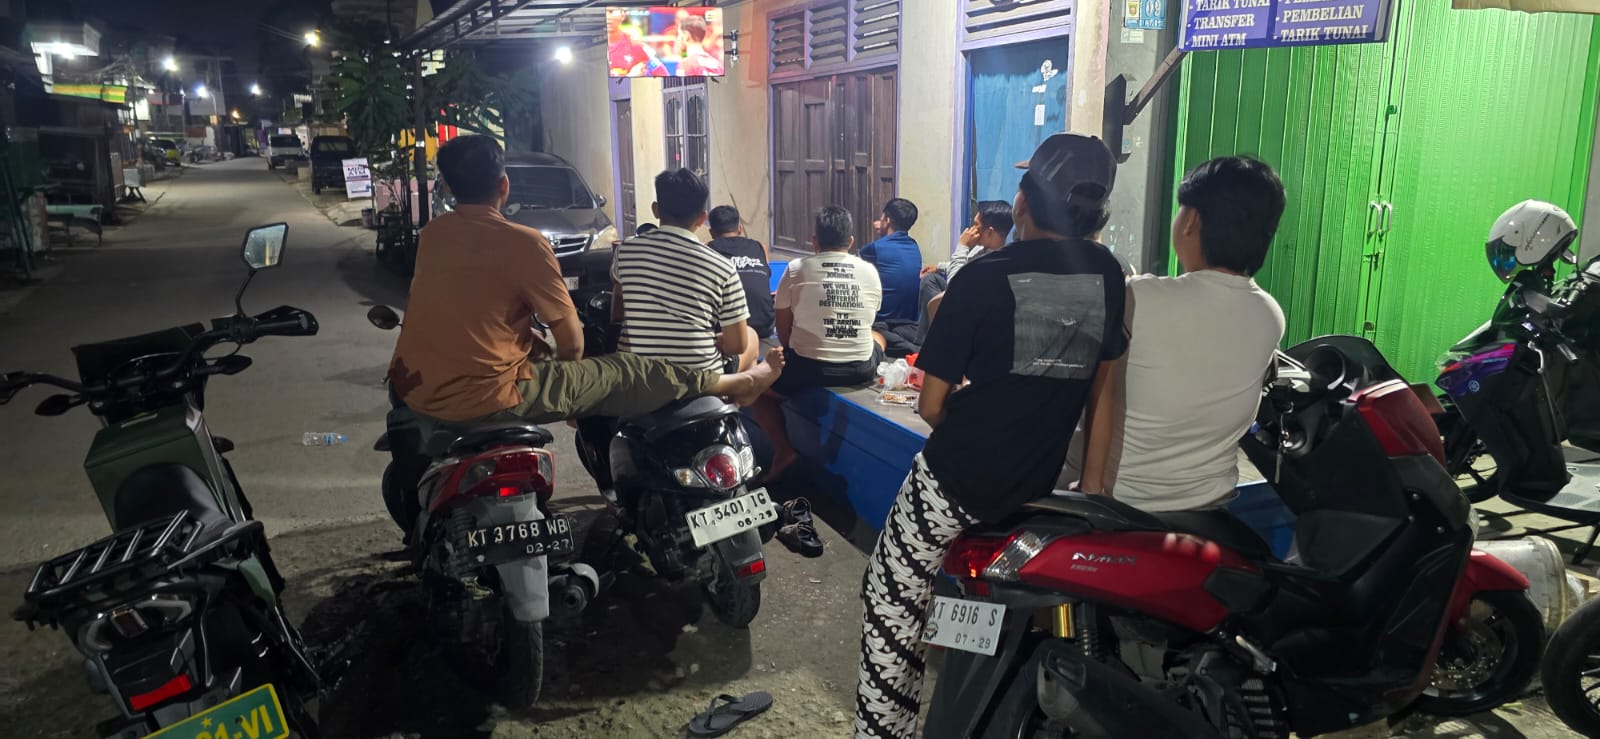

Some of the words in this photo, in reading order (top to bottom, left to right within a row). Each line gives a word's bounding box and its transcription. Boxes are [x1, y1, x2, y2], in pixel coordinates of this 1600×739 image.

[1196, 0, 1230, 11] TARIK
[1282, 5, 1364, 22] PEMBELIAN
[1194, 14, 1255, 30] TRANSFER
[1192, 34, 1219, 48] MINI
[1220, 33, 1247, 47] ATM
[1281, 28, 1320, 42] TARIK
[1324, 25, 1368, 40] TUNAI
[690, 512, 708, 529] KT
[714, 500, 745, 521] 5401
[468, 529, 487, 548] KT
[493, 522, 540, 543] 3768
[546, 518, 569, 536] WB
[950, 604, 980, 625] 6916
[988, 608, 998, 627] S
